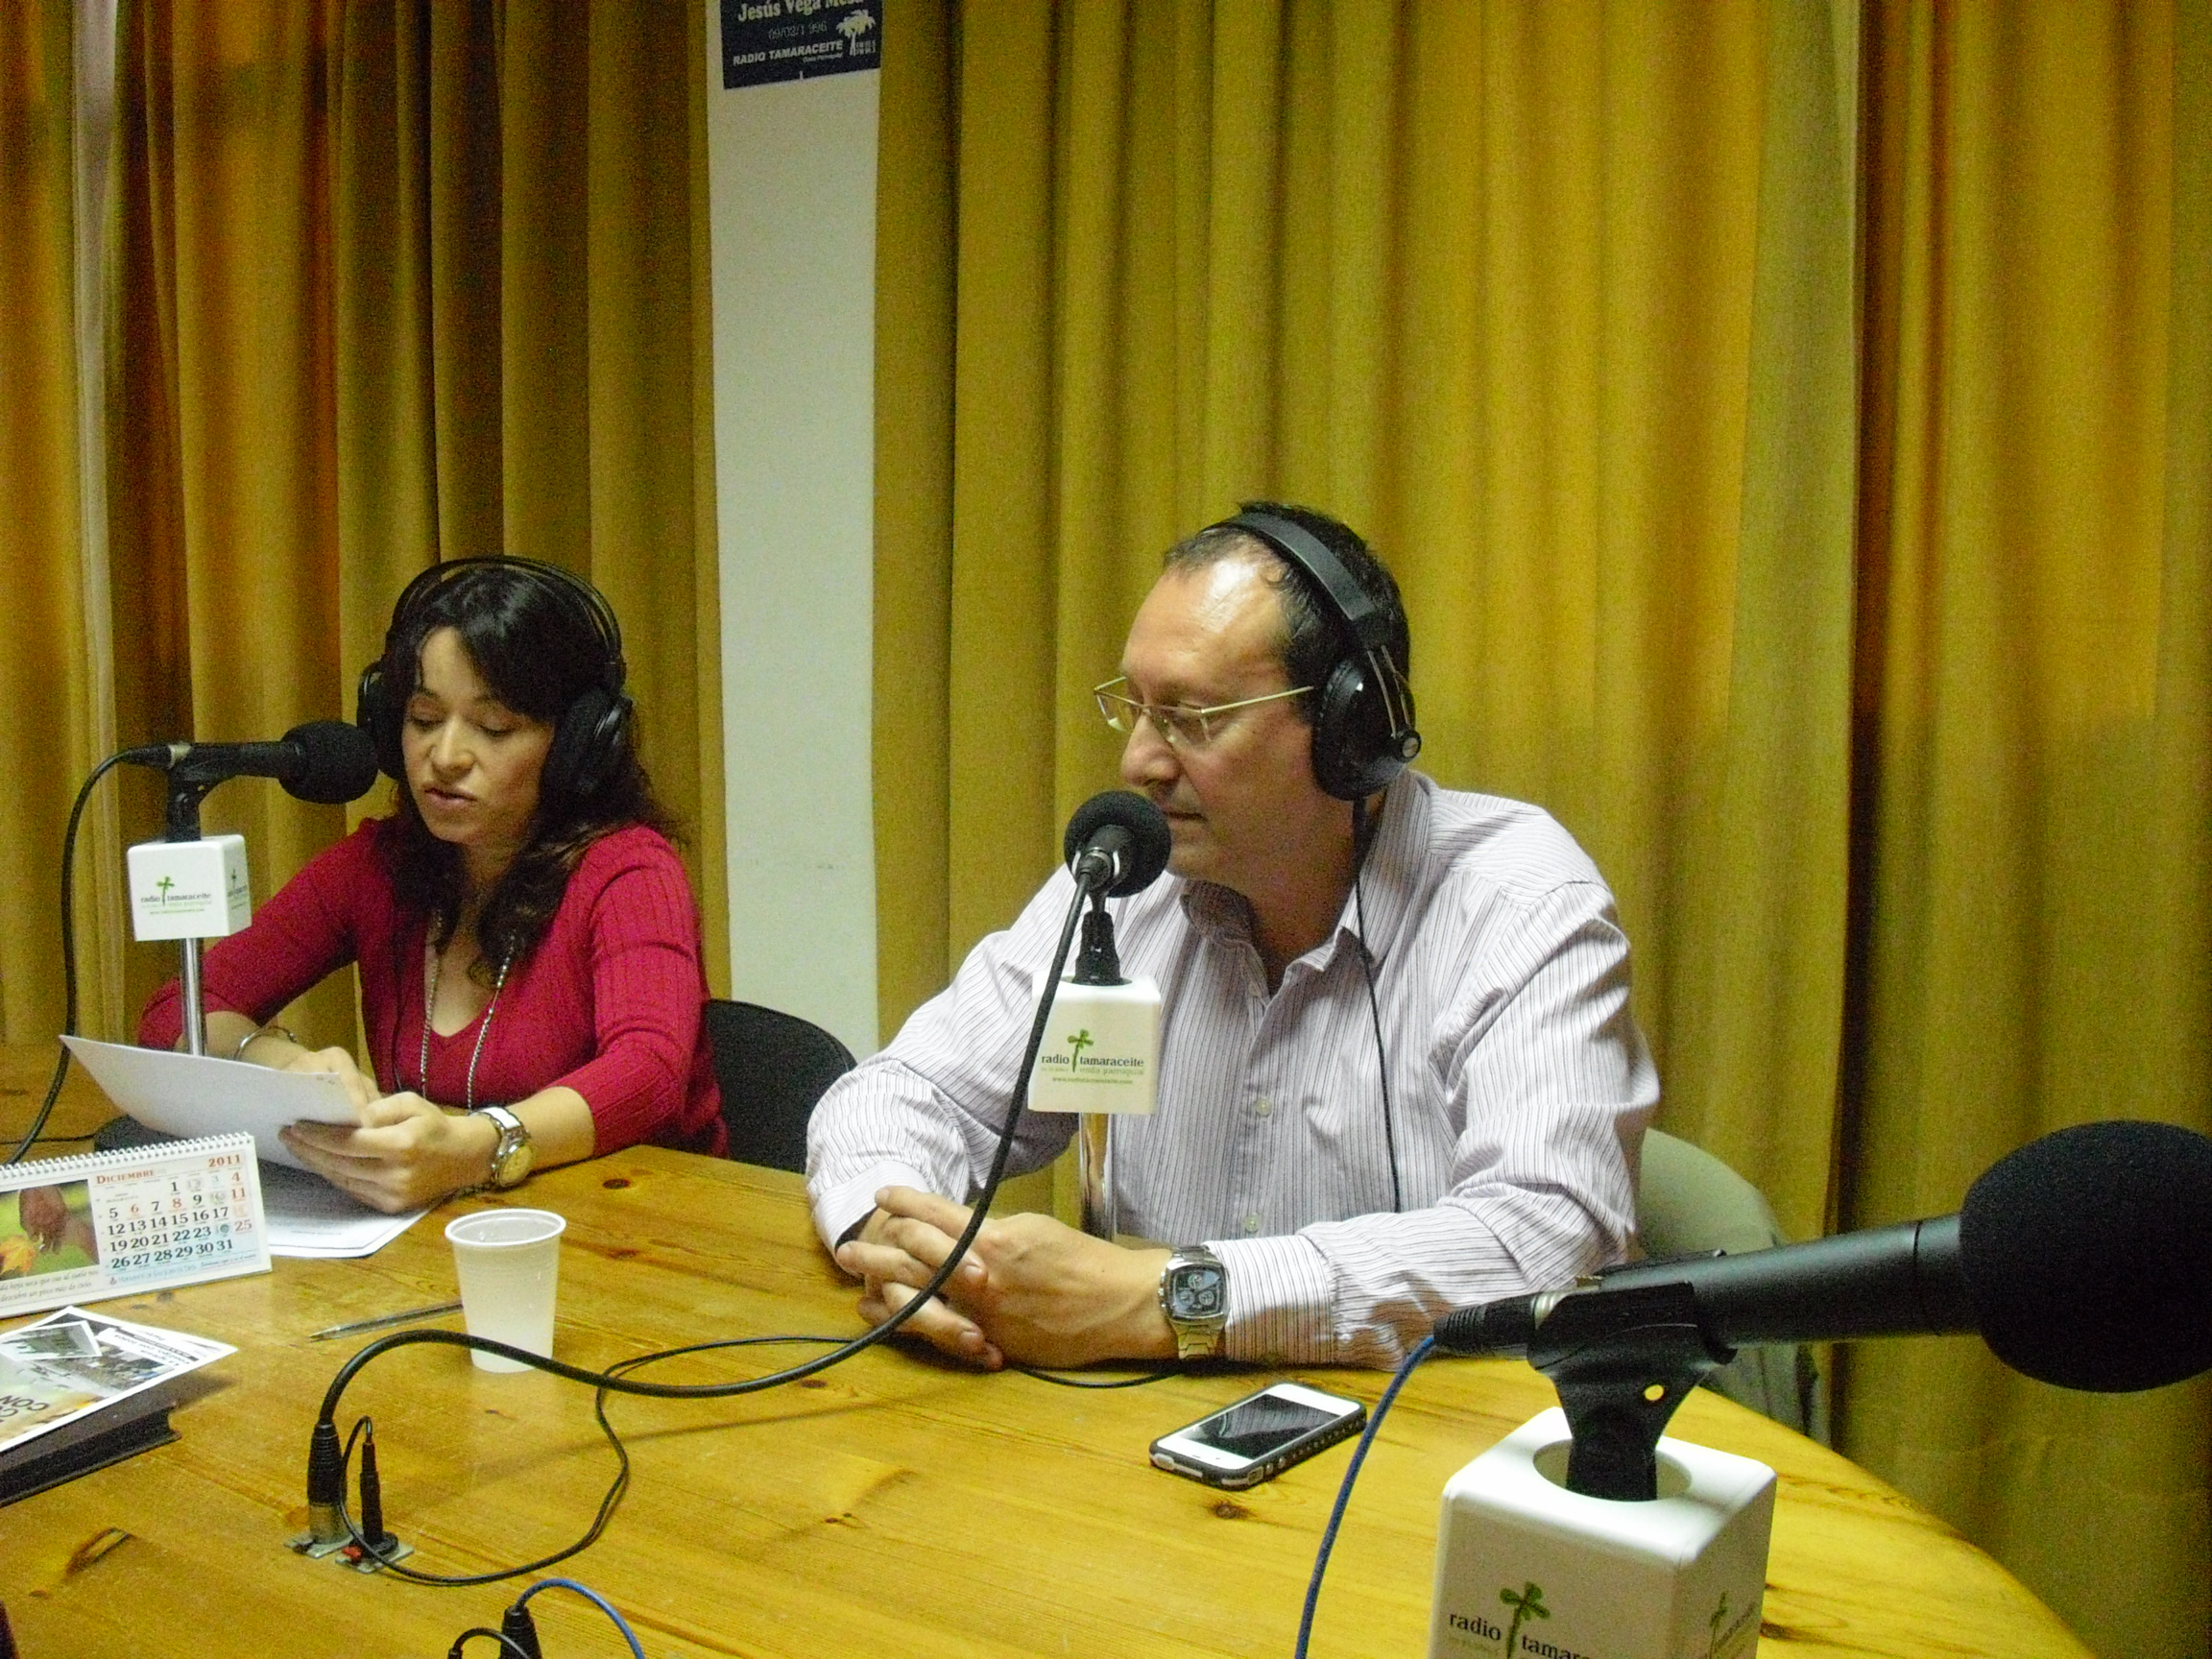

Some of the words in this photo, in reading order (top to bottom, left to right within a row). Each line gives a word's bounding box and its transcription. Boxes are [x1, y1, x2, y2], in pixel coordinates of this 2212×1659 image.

[737, 0, 781, 22] Jesús
[733, 52, 766, 65] RADIO
[769, 40, 844, 60] TAMARACEITE
[167, 893, 211, 902] tamaraceite
[1041, 1054, 1070, 1064] radio
[1080, 1055, 1144, 1067] tamaraceite
[208, 1155, 241, 1167] 2011
[171, 1181, 178, 1191] 1
[231, 1172, 240, 1182] 4
[109, 1208, 118, 1218] 5
[131, 1204, 139, 1213] 6
[151, 1201, 159, 1212] 7
[173, 1198, 181, 1208] 8
[193, 1194, 203, 1205] 9
[231, 1188, 246, 1199] 11
[108, 1223, 126, 1236] 12
[130, 1220, 146, 1232] 13
[150, 1216, 167, 1228] 14
[172, 1214, 188, 1225] 15
[193, 1210, 209, 1221] 16
[213, 1206, 228, 1218] 17
[110, 1239, 128, 1252] 19
[131, 1237, 149, 1249] 20
[152, 1234, 169, 1245] 21
[173, 1229, 190, 1241] 22
[193, 1226, 211, 1238] 23
[234, 1219, 252, 1232] 25
[111, 1256, 131, 1269] 26
[132, 1253, 151, 1265] 27
[154, 1249, 173, 1262] 28
[175, 1246, 193, 1258] 29
[196, 1242, 214, 1255] 30
[217, 1239, 232, 1251] 31
[1449, 1613, 1502, 1641] radio
